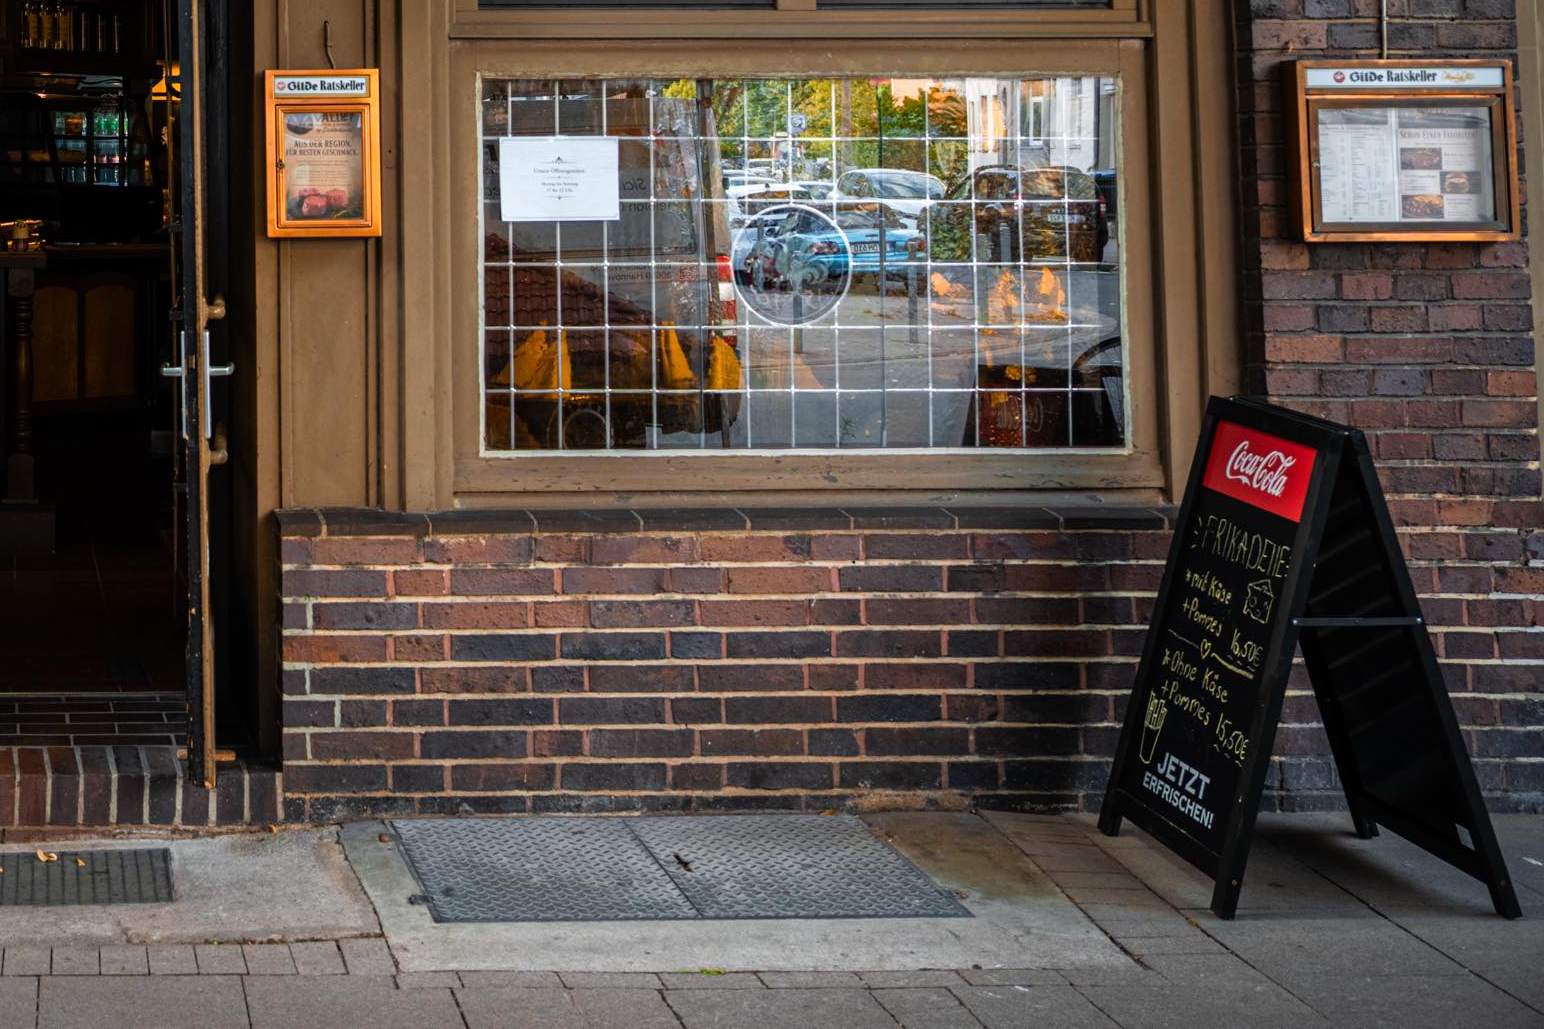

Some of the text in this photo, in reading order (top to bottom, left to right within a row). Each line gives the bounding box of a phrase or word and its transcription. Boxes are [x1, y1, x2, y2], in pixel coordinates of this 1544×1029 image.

[287, 79, 365, 91] Gilde Ratskeller
[1349, 71, 1384, 82] Gilde
[1386, 70, 1437, 82] Ratskeller
[1225, 440, 1297, 497] Coca-Cola
[1208, 575, 1232, 604] Käse
[1202, 667, 1229, 703] Käse
[1157, 752, 1211, 800] JETZT
[1142, 771, 1215, 830] ERFRISCHEN!
